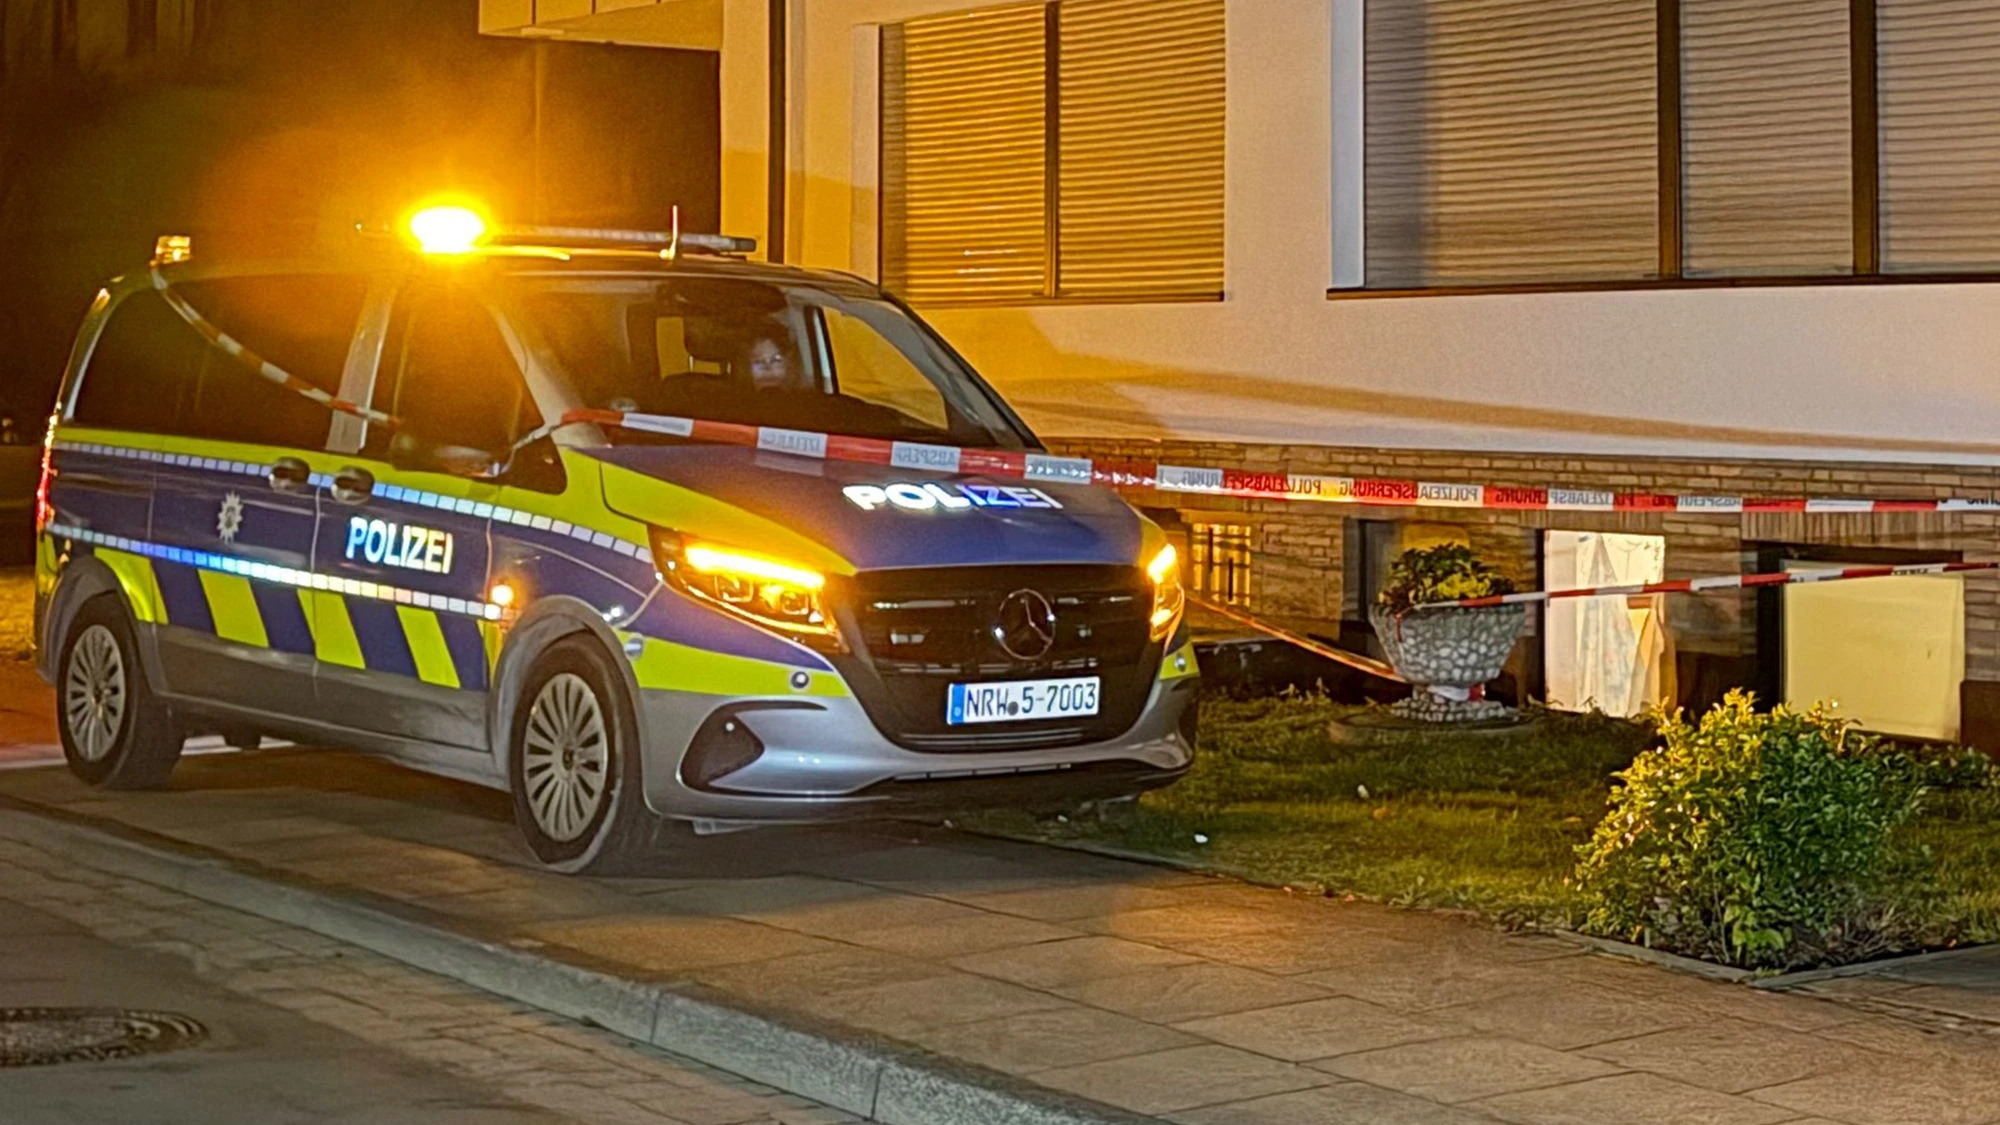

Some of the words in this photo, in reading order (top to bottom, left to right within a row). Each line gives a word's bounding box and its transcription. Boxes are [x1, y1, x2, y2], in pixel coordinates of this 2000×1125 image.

[842, 483, 1064, 510] POLIZEI
[345, 516, 454, 574] POLIZEI
[966, 687, 1009, 717] NRW
[1021, 682, 1097, 714] 5-7003
